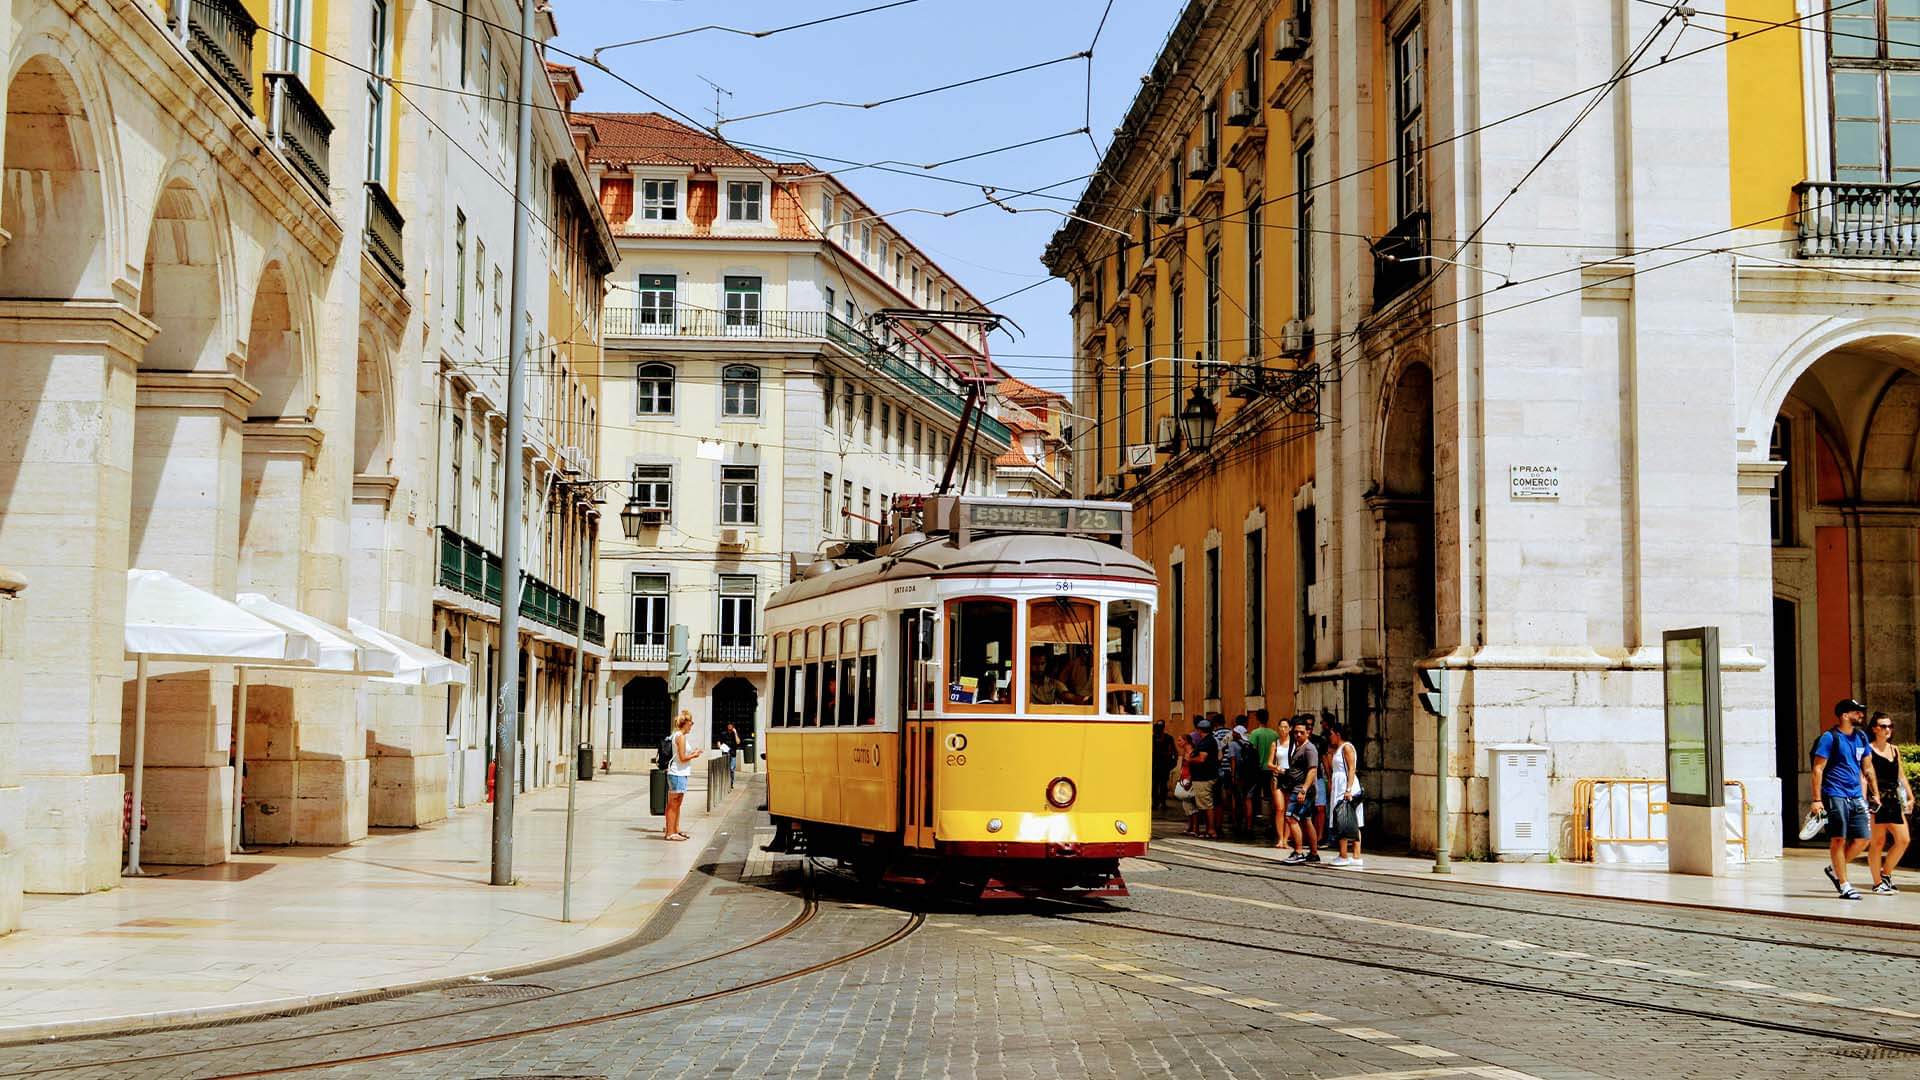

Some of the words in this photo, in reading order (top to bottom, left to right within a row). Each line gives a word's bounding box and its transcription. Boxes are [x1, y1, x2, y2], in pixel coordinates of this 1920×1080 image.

[1513, 478, 1559, 487] COMERCIO
[1079, 510, 1108, 529] 25
[1055, 581, 1073, 591] 581
